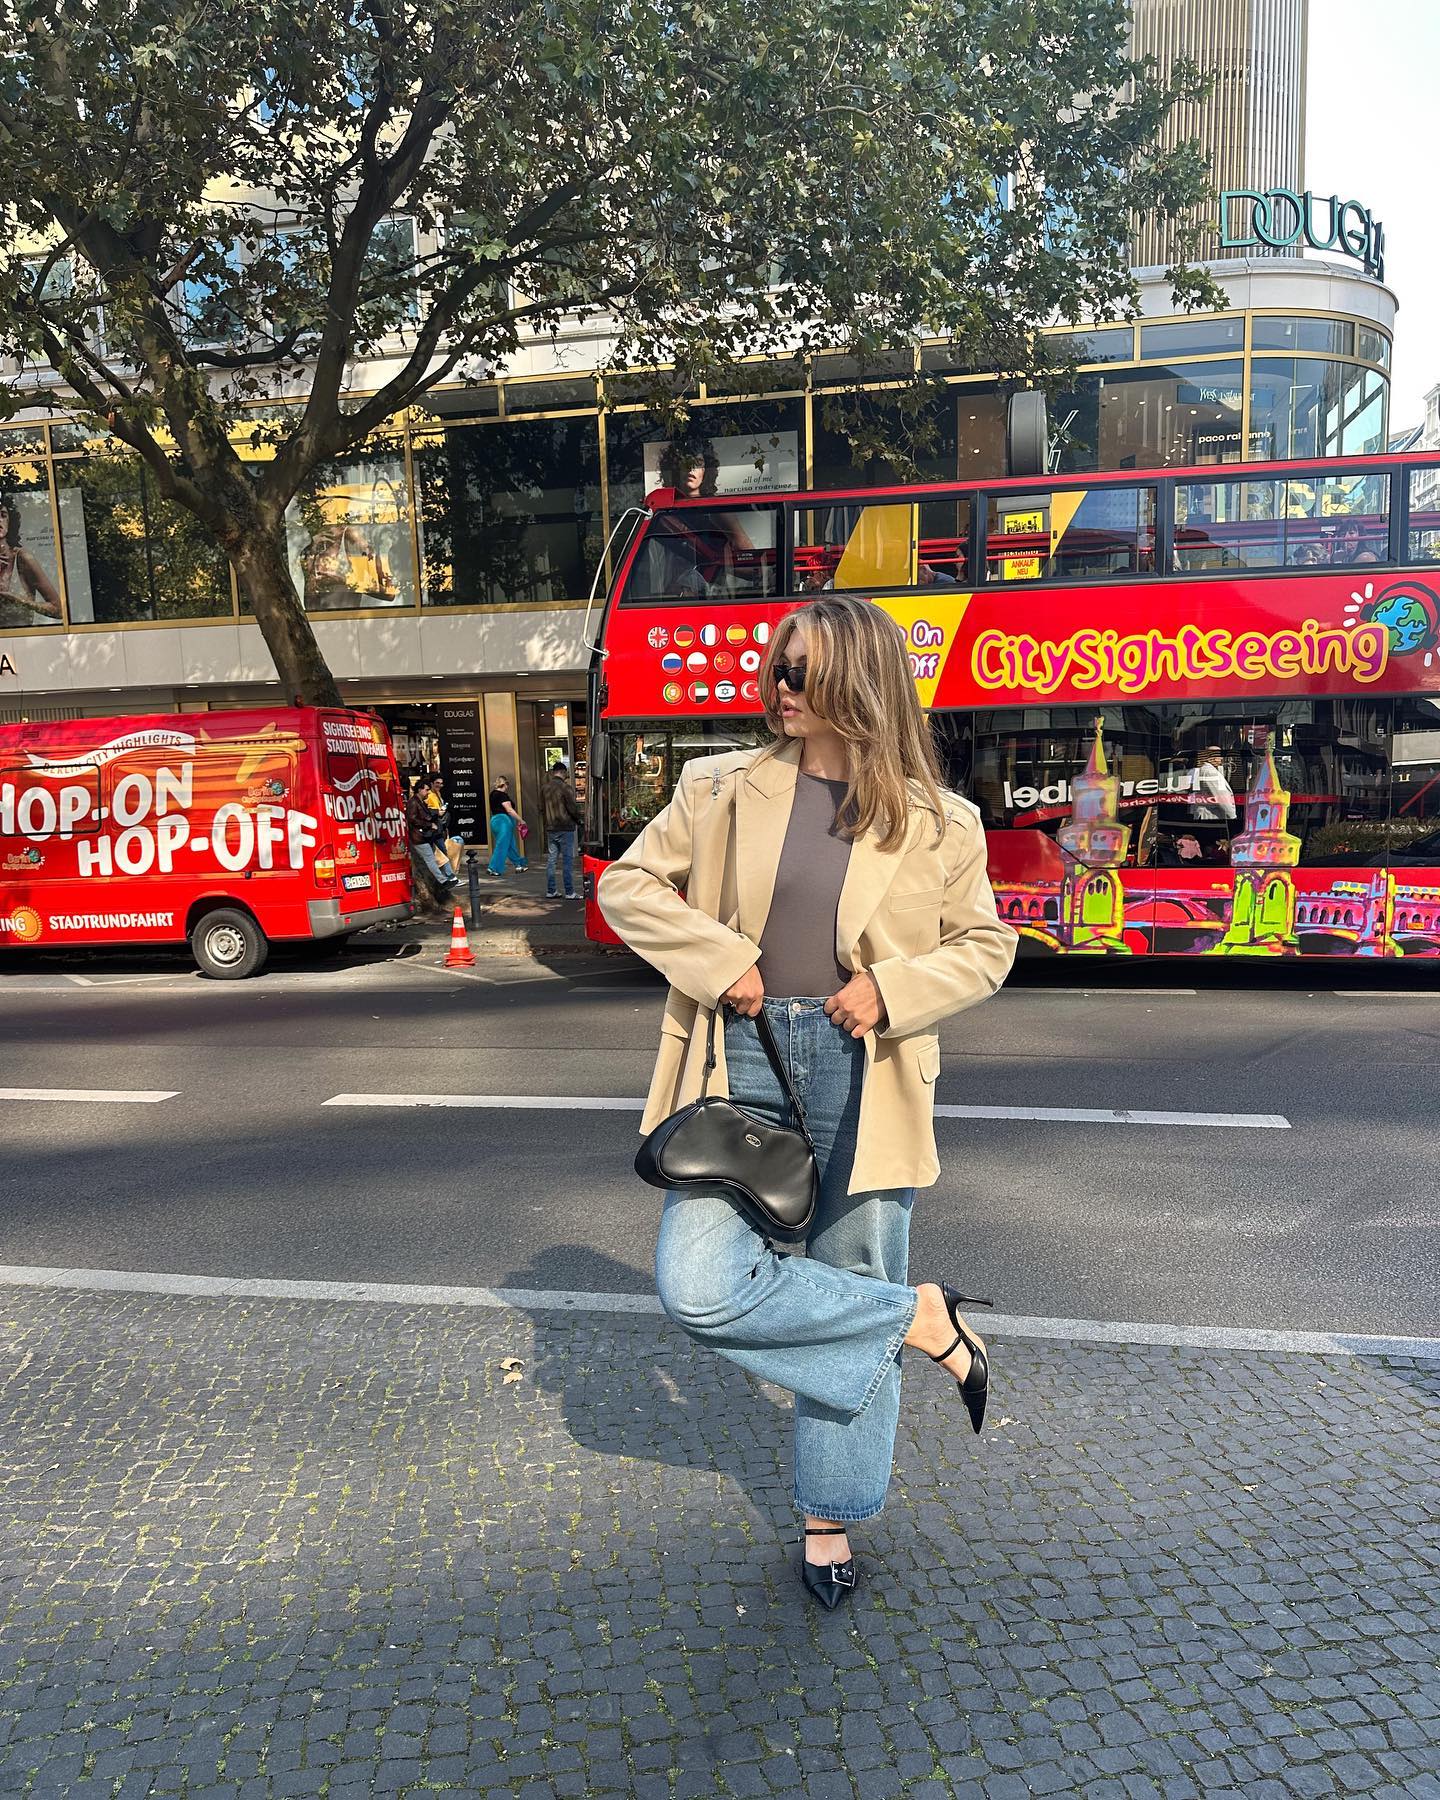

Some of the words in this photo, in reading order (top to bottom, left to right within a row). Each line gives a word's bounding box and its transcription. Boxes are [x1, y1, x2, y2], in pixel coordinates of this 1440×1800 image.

[1199, 433, 1225, 444] paco
[724, 485, 753, 493] narciso
[755, 483, 792, 491] rodriguez
[743, 476, 752, 484] all
[1012, 559, 1035, 569] ANKAUF
[1017, 568, 1029, 576] NEU
[911, 619, 945, 648] On
[971, 618, 1389, 695] CitySightseeing
[444, 710, 475, 718] DOUGLAS
[323, 722, 372, 740] SIGHTSEEING
[43, 762, 83, 775] BERLI
[112, 734, 182, 754] HIGHLIGHTS
[326, 738, 388, 757] STADTRUNDFAHRT
[323, 784, 380, 821] HOP-ON
[464, 792, 477, 800] FORD
[355, 807, 407, 842] HOP-OFF
[77, 802, 318, 877] HOP-OFF
[49, 912, 174, 930] STADTRUNDFAHRT
